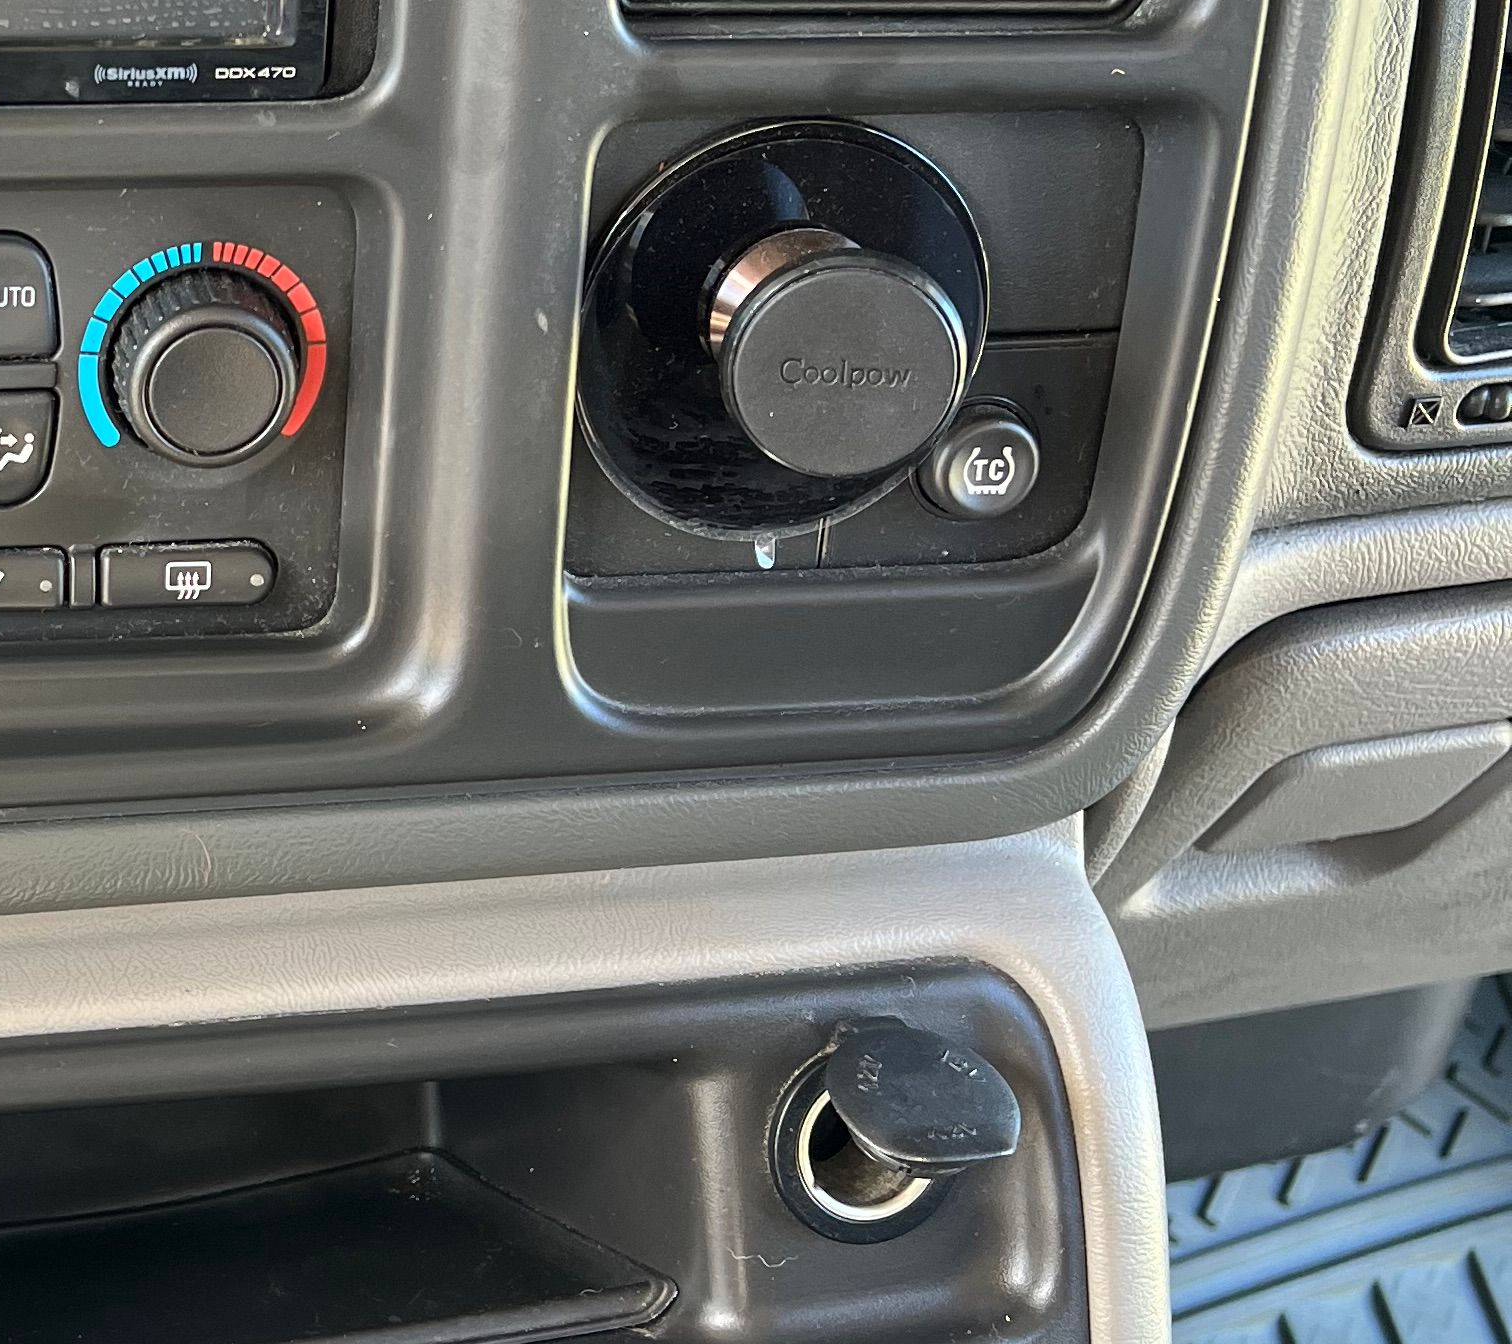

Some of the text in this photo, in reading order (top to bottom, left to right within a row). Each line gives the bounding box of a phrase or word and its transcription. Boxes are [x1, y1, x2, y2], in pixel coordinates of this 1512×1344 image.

[214, 66, 296, 80] DDX470
[780, 358, 912, 390] Coolpow
[973, 458, 1005, 482] TC
